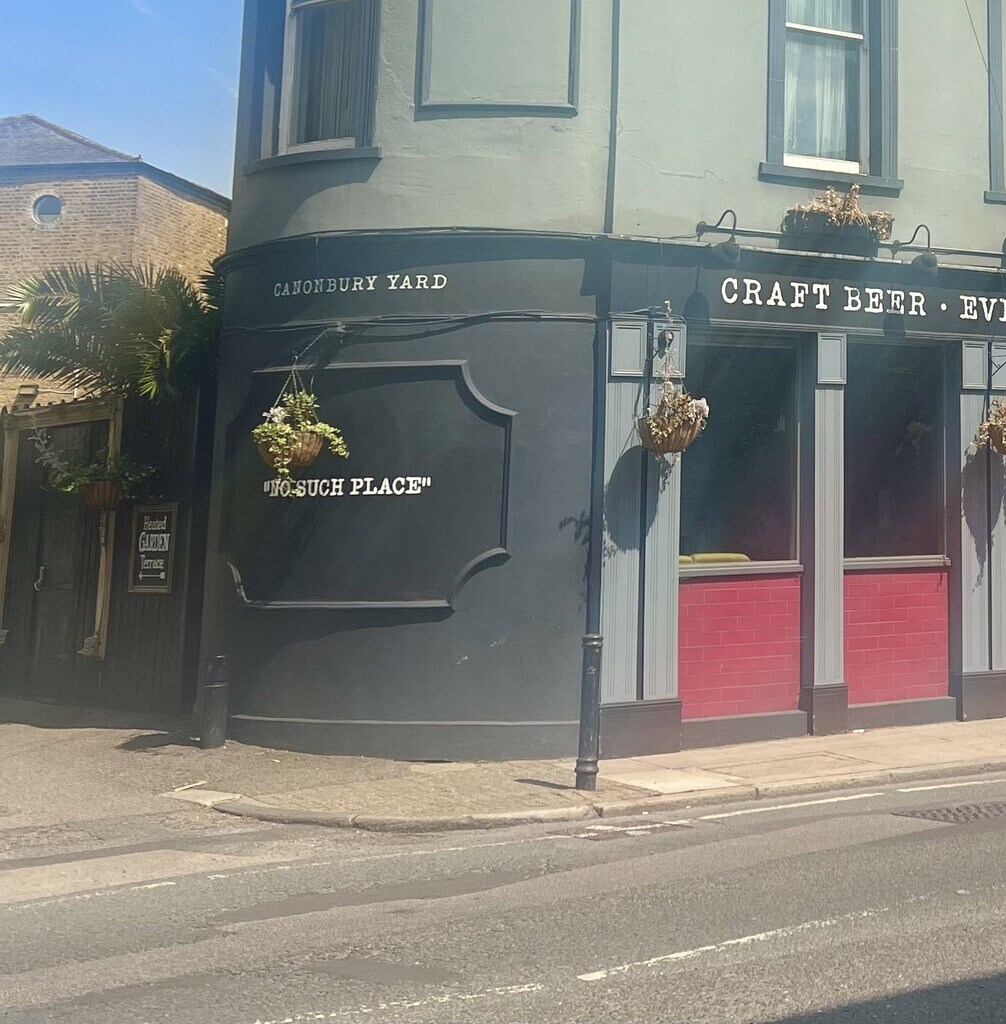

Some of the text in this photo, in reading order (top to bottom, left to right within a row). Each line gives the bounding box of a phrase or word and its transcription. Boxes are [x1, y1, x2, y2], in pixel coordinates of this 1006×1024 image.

[273, 274, 448, 297] CANONBURY YARD
[721, 277, 830, 310] CRAFT
[843, 285, 927, 317] BEER
[296, 478, 345, 497] SUCH
[350, 476, 432, 495] PLACE"
[143, 515, 168, 530] Heated
[138, 531, 171, 552] GARDEN
[140, 554, 165, 569] Terrace
